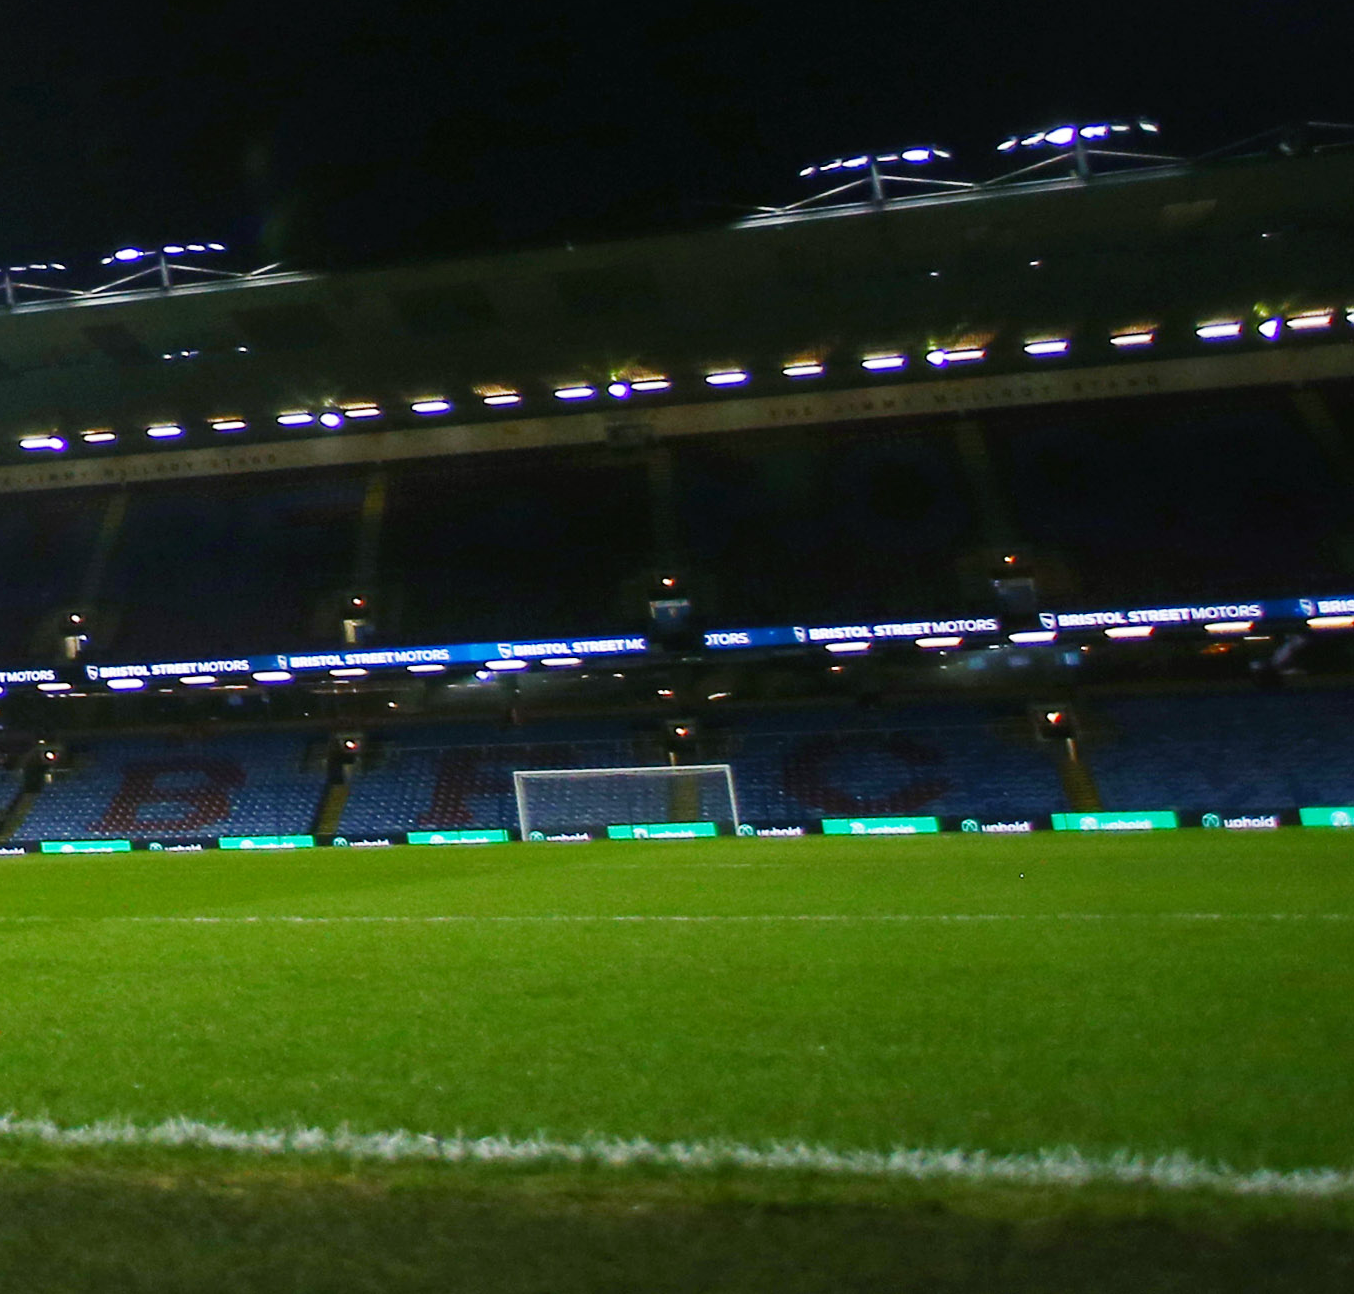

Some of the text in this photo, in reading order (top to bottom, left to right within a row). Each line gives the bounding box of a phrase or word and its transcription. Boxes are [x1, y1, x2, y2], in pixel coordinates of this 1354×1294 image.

[1057, 603, 1261, 627] BRISTOL STREET MOTORS
[808, 618, 997, 641] BRISTOL STREET MOTORS
[290, 648, 450, 668] BRISTOL STREET MOTORS
[513, 642, 571, 657] BRISTOL
[572, 639, 625, 654] STREET
[7, 669, 55, 683] MOTORS
[99, 659, 250, 679] BRISTOL STREET MOTORS
[1224, 815, 1277, 827] uphold
